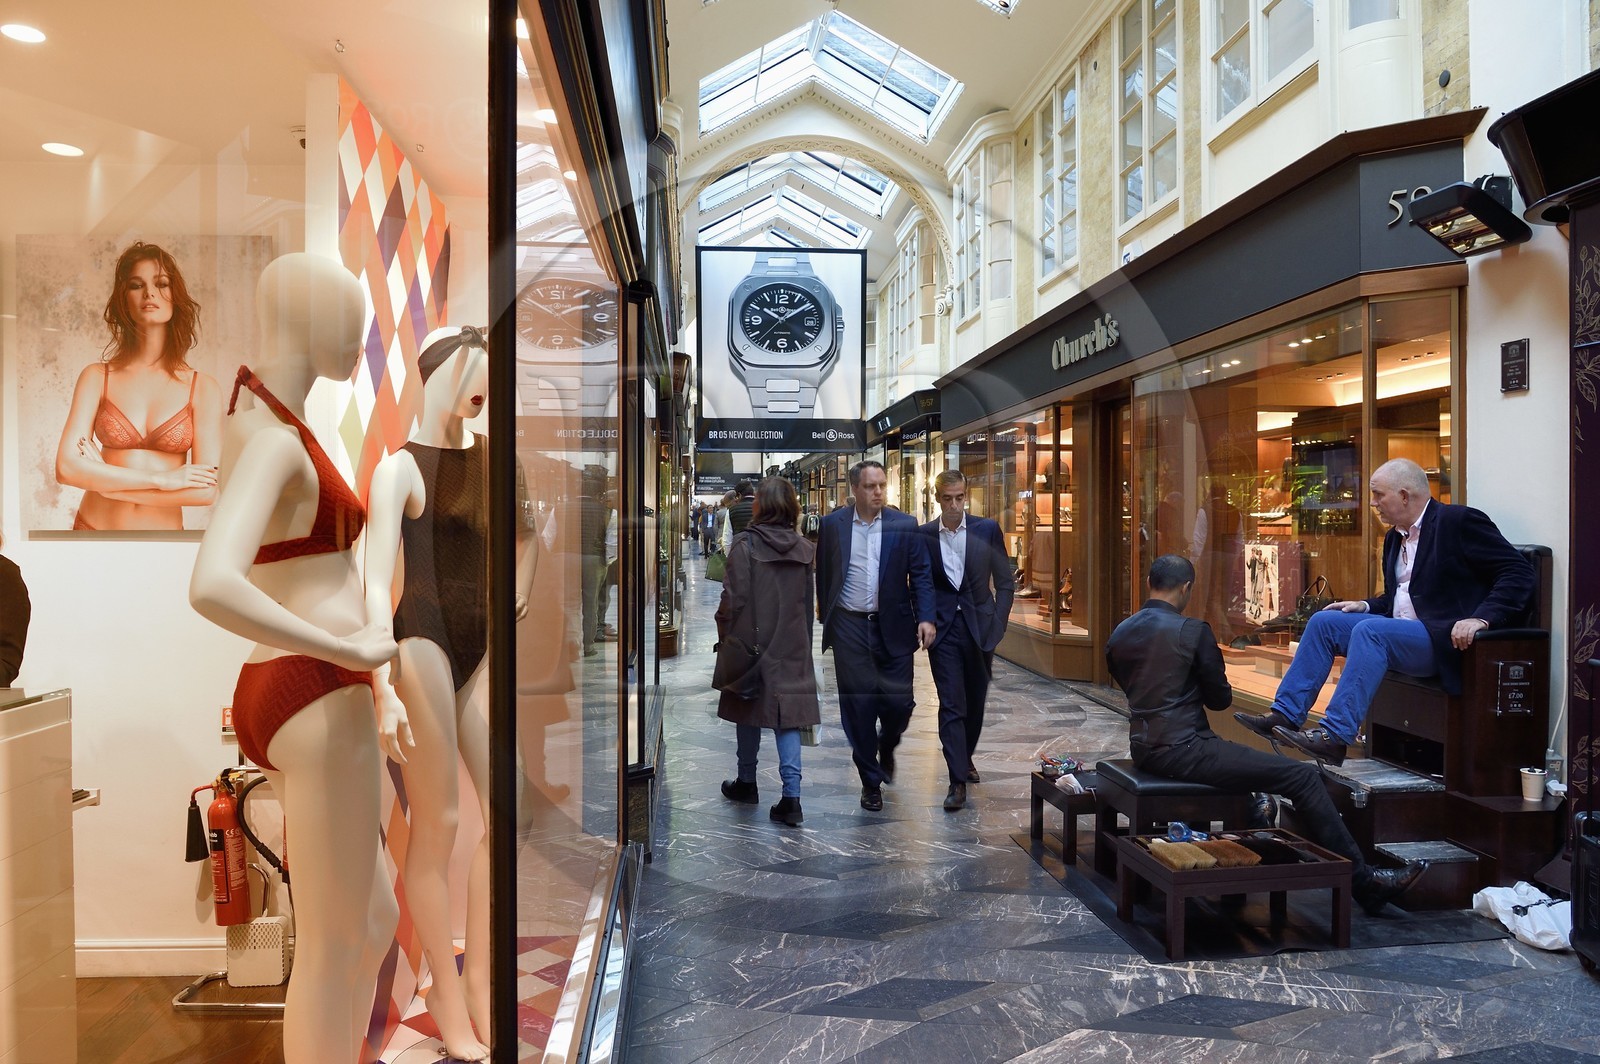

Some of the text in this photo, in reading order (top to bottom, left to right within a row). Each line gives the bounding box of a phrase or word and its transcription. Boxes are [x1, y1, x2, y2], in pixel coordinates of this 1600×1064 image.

[775, 294, 789, 304] 12
[751, 315, 762, 325] 9
[776, 338, 788, 348] 6
[1051, 312, 1120, 371] Church's
[708, 430, 784, 440] BR 05 NEW COLLECTION
[811, 429, 855, 441] Bell & Ross
